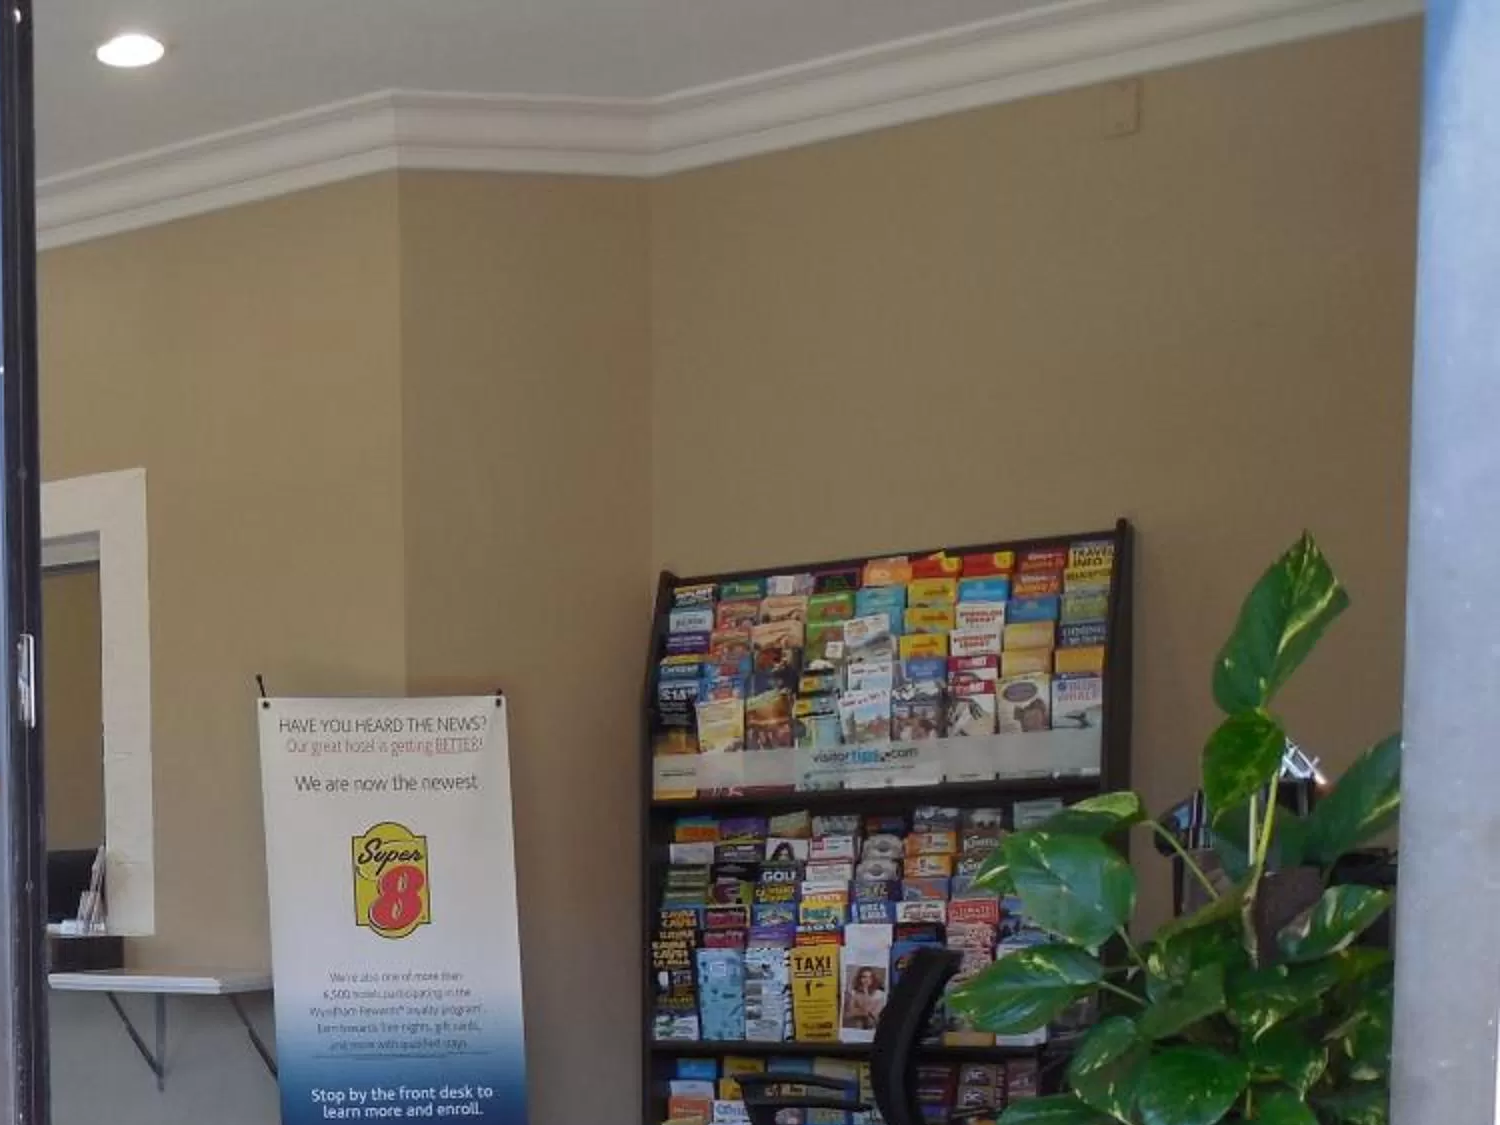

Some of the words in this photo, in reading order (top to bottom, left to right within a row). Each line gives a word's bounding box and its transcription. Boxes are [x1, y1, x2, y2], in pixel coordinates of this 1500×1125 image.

[279, 717, 316, 733] HAVE
[320, 717, 351, 733] YOU
[355, 717, 404, 733] HEARD
[407, 717, 433, 732] THE
[437, 715, 487, 732] NEWS?
[288, 739, 306, 753] Our
[310, 740, 342, 757] great
[390, 739, 434, 757] getting
[295, 775, 321, 791] We
[325, 778, 349, 792] are
[353, 777, 388, 792] now
[392, 773, 418, 791] the
[421, 773, 479, 791] newest
[357, 837, 424, 876] Super
[368, 864, 425, 930] 8
[794, 956, 831, 971] TAXI
[311, 1088, 345, 1104] Stop
[349, 1086, 367, 1104] by
[371, 1087, 396, 1101] the
[400, 1085, 436, 1100] front
[439, 1084, 473, 1099] desk
[477, 1086, 493, 1098] to
[323, 1105, 361, 1119] learn
[365, 1106, 403, 1118] more
[407, 1102, 433, 1117] and
[437, 1101, 485, 1117] enroll.
